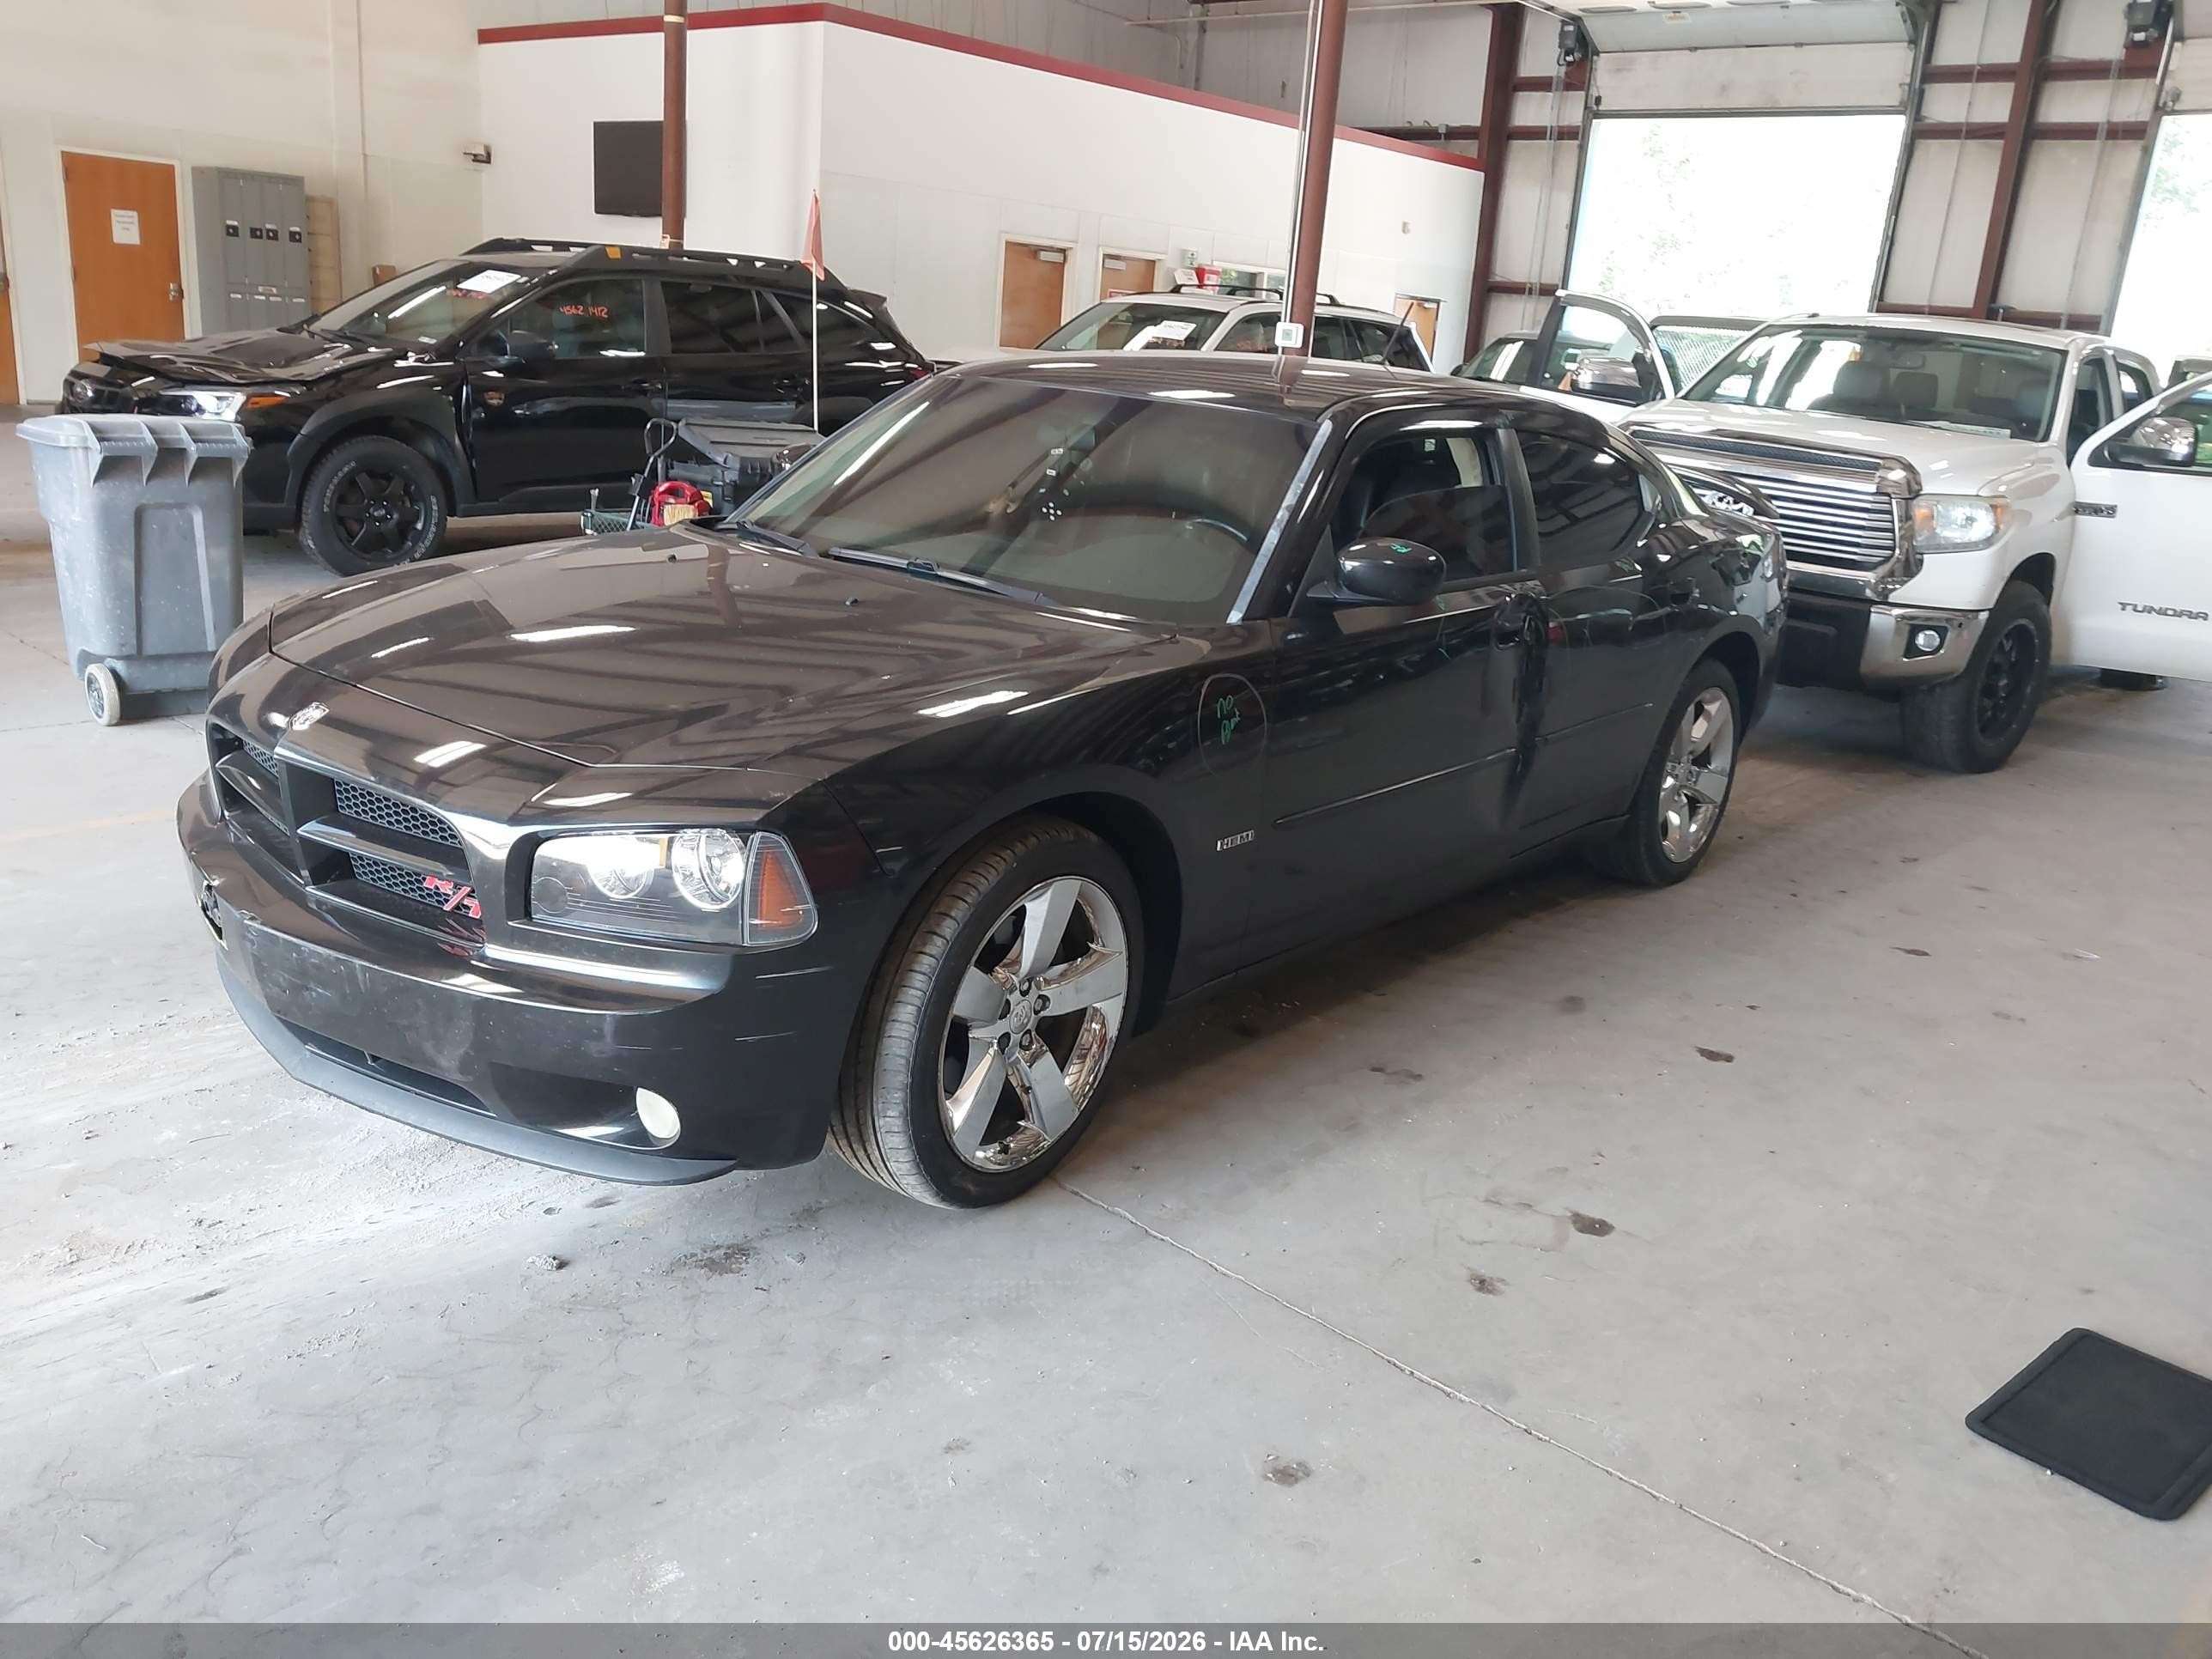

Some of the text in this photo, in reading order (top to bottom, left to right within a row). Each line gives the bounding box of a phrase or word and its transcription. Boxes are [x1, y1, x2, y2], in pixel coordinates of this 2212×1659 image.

[2117, 601, 2209, 621] TUNDRA
[1216, 830, 1255, 851] HEMI
[423, 875, 482, 919] R/T
